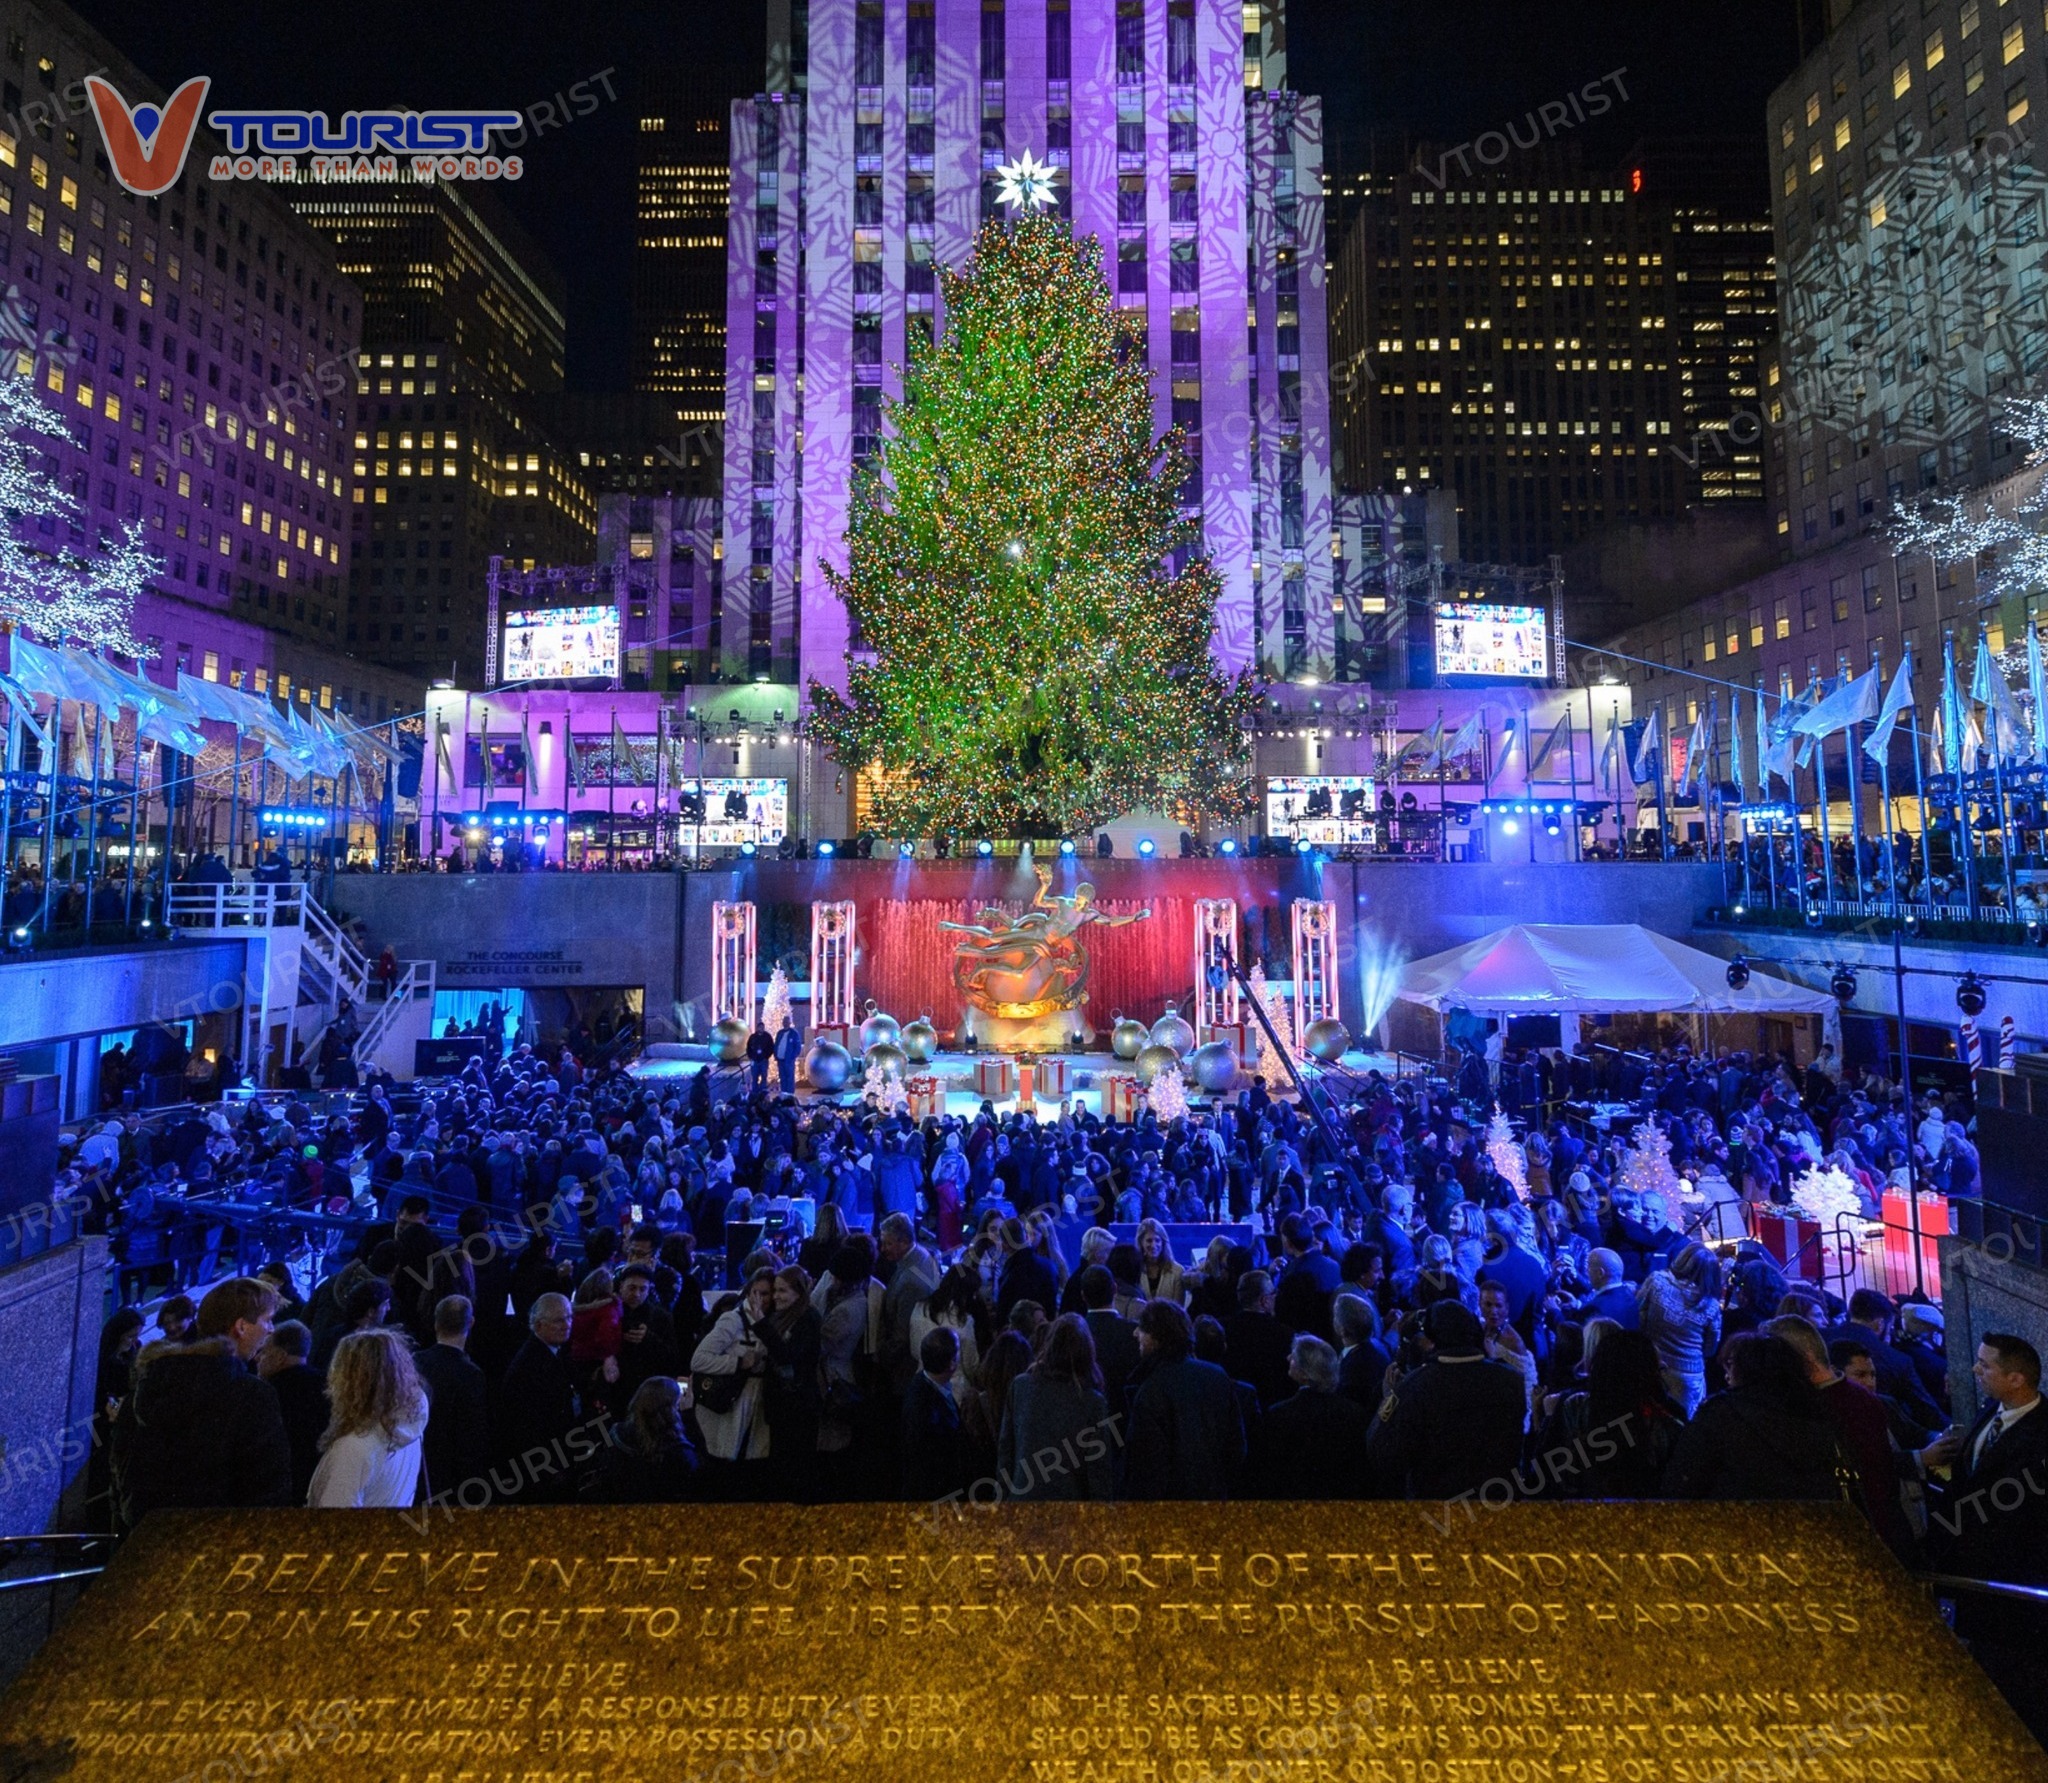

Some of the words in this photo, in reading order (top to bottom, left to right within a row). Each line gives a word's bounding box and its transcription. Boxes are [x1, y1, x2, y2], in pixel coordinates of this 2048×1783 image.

[467, 951, 490, 960] THE
[492, 951, 564, 960] CONCOURSE
[446, 965, 530, 975] ROCKEFELLER
[535, 965, 582, 974] CENTER
[213, 1552, 498, 1594] BELIEVE
[512, 1558, 585, 1594] IN
[603, 1556, 715, 1593] THE
[1016, 1553, 1226, 1590] WORTH
[1245, 1552, 1310, 1588] OF
[1326, 1552, 1441, 1588] THE
[1459, 1552, 1833, 1588] INDIVIDUAL
[129, 1610, 252, 1642] AND
[338, 1608, 433, 1642] HIS
[440, 1607, 606, 1641] RIGHT
[619, 1606, 680, 1640] TO
[822, 1604, 1021, 1639] LIBERTY
[1036, 1603, 1142, 1637] AND
[1159, 1603, 1256, 1636] THE
[1274, 1602, 1487, 1637] PURSUIT
[1507, 1602, 1568, 1634] OF
[1585, 1601, 1860, 1634] HAPPINESS
[467, 1662, 628, 1689] BELIEVE
[1391, 1658, 1556, 1683] BELIEVE
[81, 1699, 171, 1723] THAT
[173, 1699, 286, 1722] EVERY
[400, 1697, 535, 1721] IMPLIES
[537, 1697, 564, 1720] A
[864, 1695, 967, 1718] EVERY
[1029, 1694, 1063, 1718] IN
[1069, 1693, 1134, 1718] THE
[1146, 1693, 1342, 1717] SACREDNESS
[1352, 1693, 1389, 1716] OF
[1399, 1693, 1423, 1717] A
[1574, 1692, 1657, 1715] THAT
[1671, 1692, 1693, 1715] A
[1698, 1690, 1801, 1715] MAN'S
[538, 1729, 640, 1752] EVERY
[1030, 1726, 1153, 1749] SHOULD
[1164, 1726, 1200, 1748] BE
[1209, 1726, 1245, 1748] AS
[1255, 1725, 1341, 1748] GOOD
[1352, 1725, 1389, 1748] AS
[1400, 1724, 1450, 1748] HIS
[1564, 1724, 1648, 1748] THAT
[1030, 1760, 1159, 1783] WEALTH
[1349, 1759, 1399, 1783] OR
[1621, 1758, 1660, 1783] OF
[1834, 1757, 1963, 1783] WORTH
